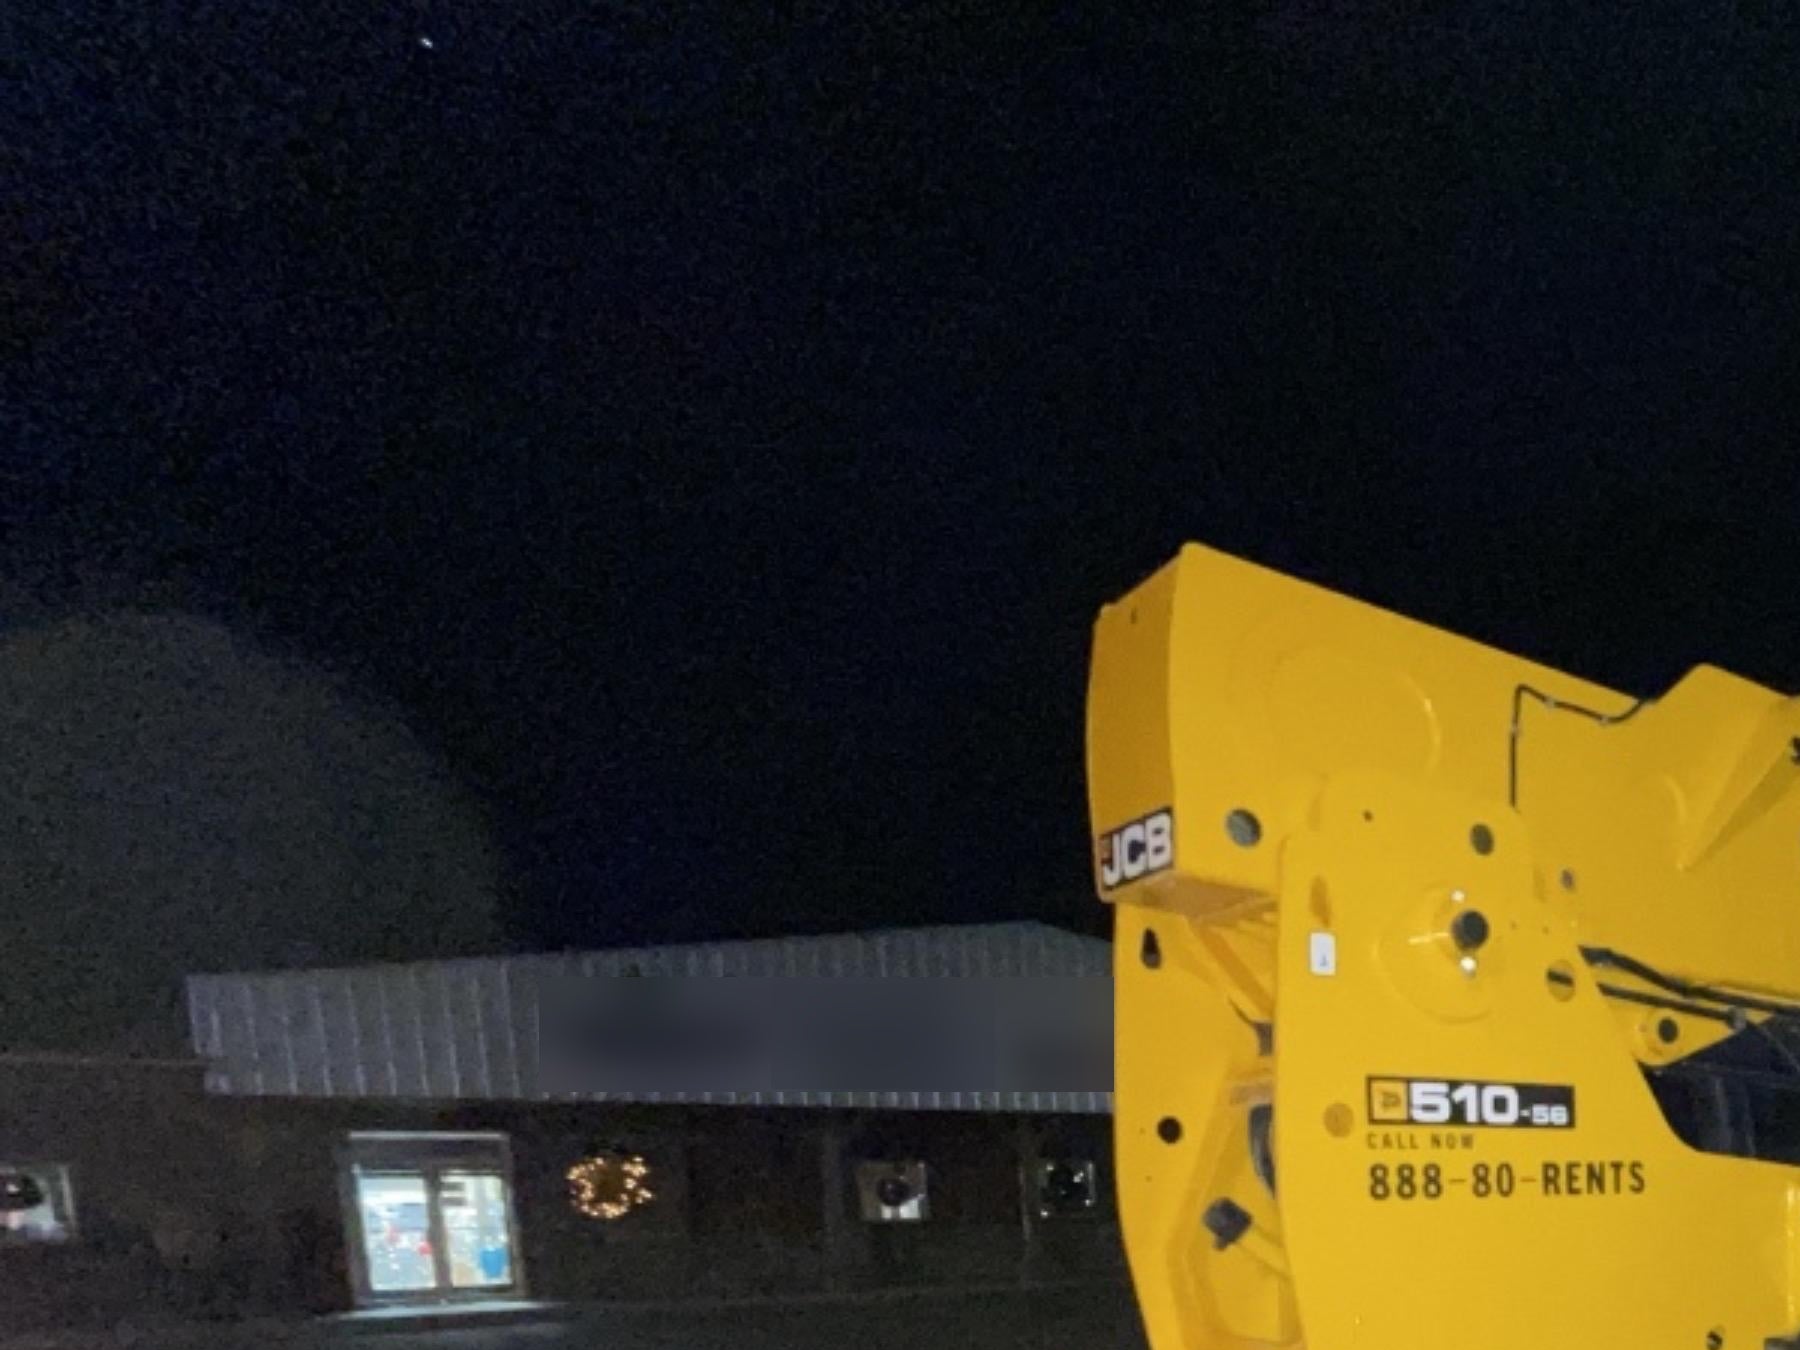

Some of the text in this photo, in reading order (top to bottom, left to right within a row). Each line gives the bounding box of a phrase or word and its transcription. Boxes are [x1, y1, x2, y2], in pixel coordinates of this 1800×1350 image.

[1102, 811, 1171, 886] JCB
[1366, 1132, 1475, 1150] CALL NOW
[1368, 1161, 1646, 1200] 888-80-RENTS
